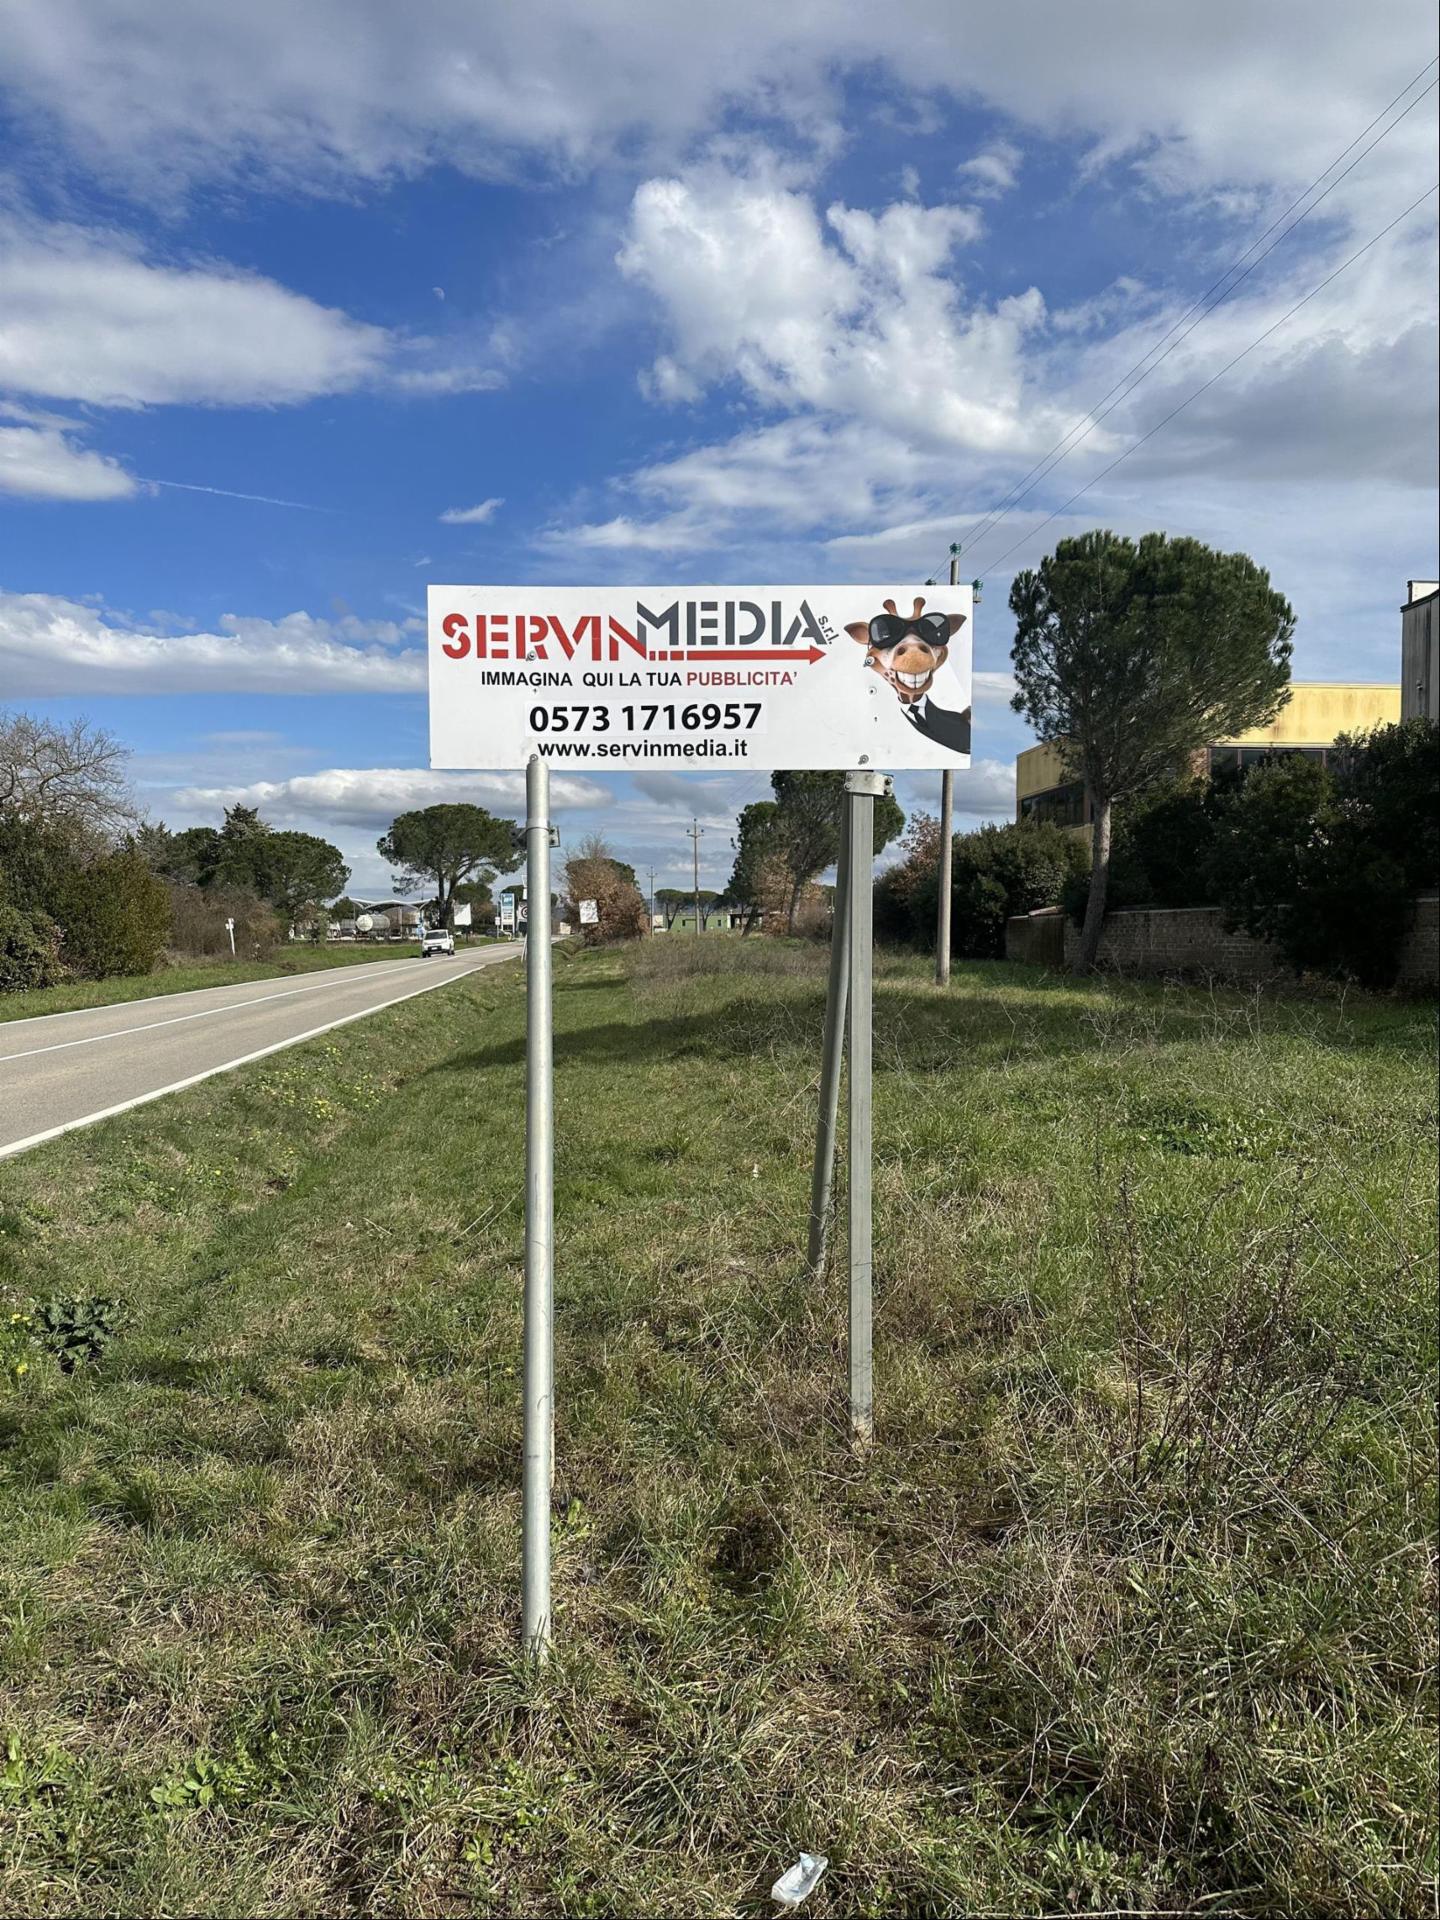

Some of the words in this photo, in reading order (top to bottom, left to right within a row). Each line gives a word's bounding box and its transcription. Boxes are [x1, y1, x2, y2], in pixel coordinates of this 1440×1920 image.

[818, 615, 840, 645] s.r.l.
[481, 671, 573, 687] IMMAGINA
[582, 671, 613, 688] QUI
[619, 671, 642, 687] LA
[646, 671, 682, 687] TUA
[529, 705, 610, 733] 0573
[621, 702, 762, 732] 1716957
[537, 738, 748, 758] www.servinmedia.it
